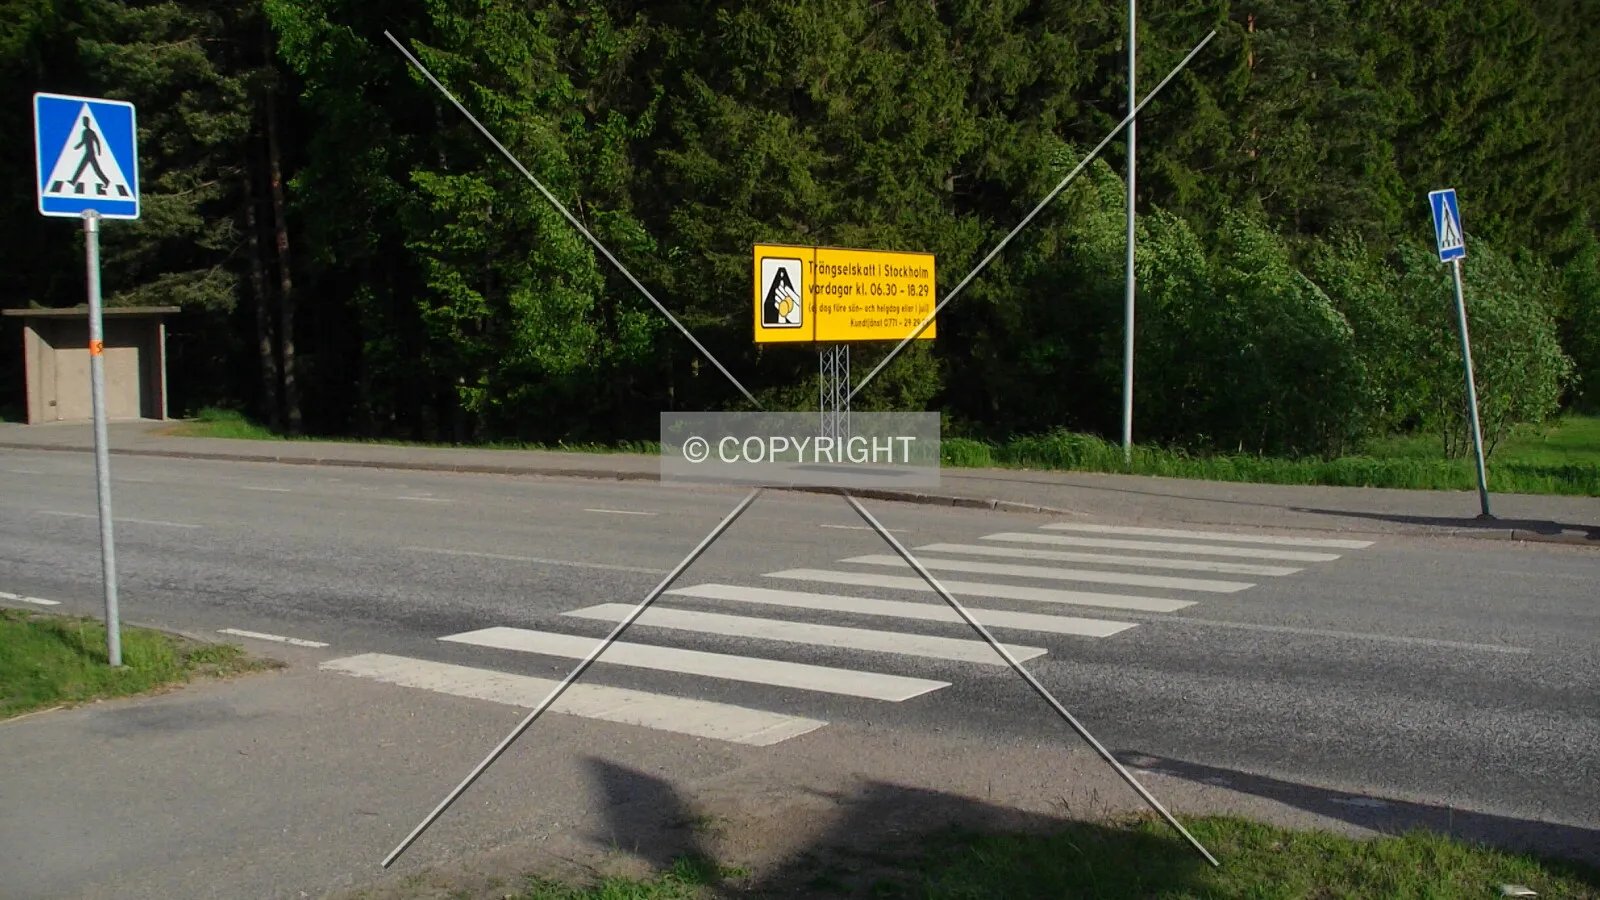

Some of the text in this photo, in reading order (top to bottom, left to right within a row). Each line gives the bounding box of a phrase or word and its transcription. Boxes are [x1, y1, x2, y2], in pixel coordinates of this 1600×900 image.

[808, 260, 929, 279] Trängselskatt i Stockholm
[808, 282, 853, 298] vardagar
[856, 283, 867, 296] kl.
[870, 283, 897, 296] 06.30
[907, 284, 929, 297] 18.29
[819, 304, 832, 315] dag
[864, 304, 874, 313] och
